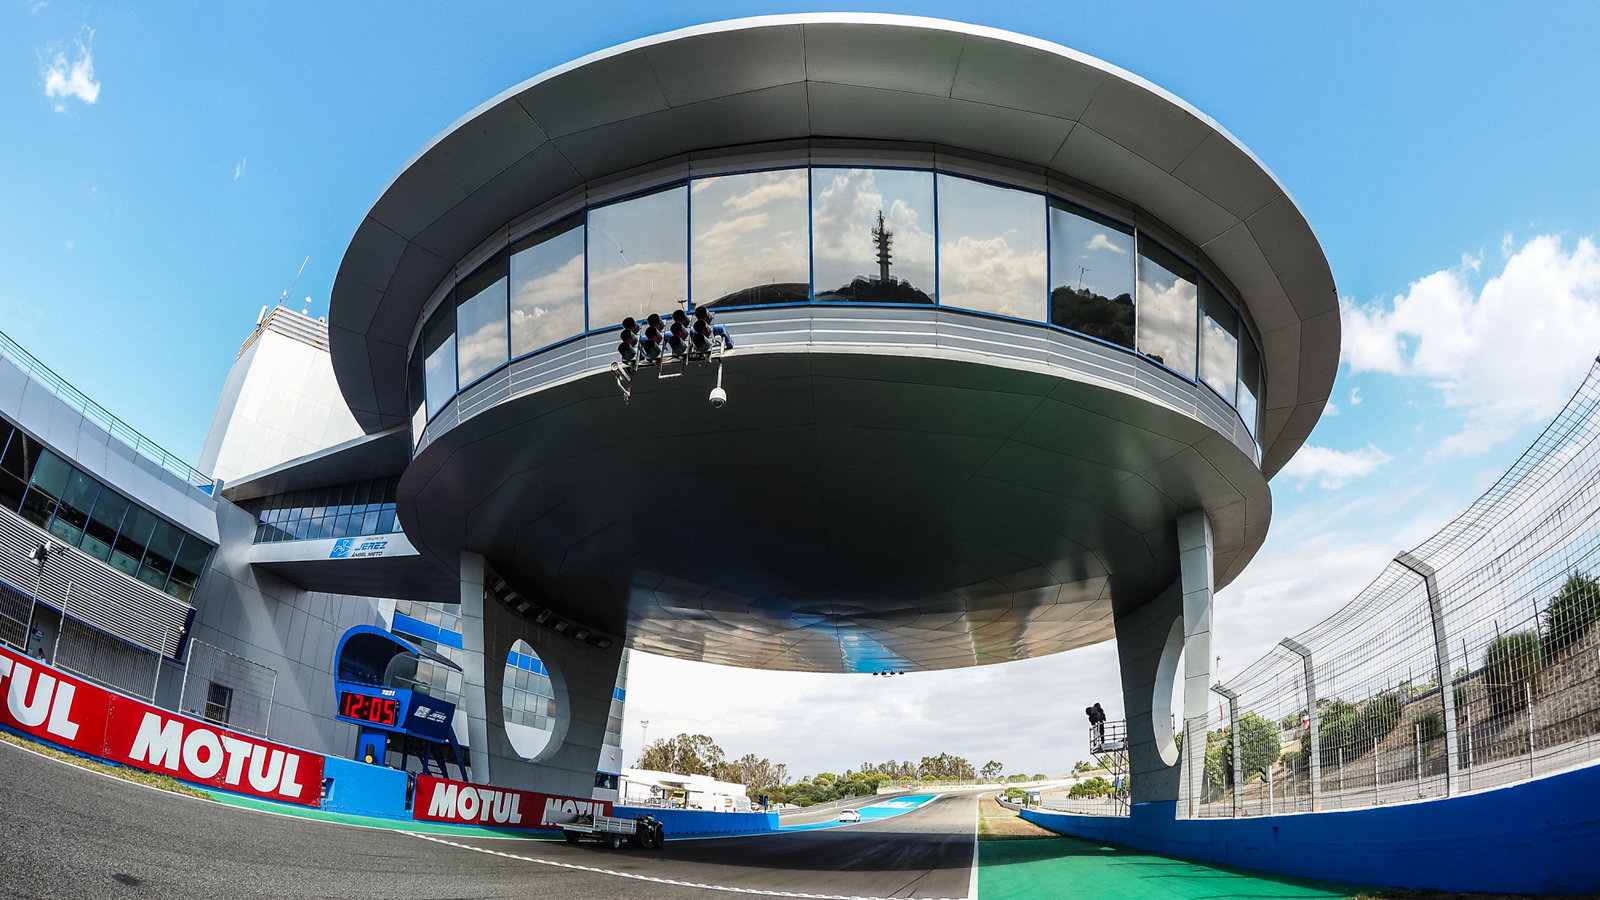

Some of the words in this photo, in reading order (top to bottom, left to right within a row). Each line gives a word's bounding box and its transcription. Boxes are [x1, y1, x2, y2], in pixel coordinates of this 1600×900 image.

[354, 541, 389, 551] JEREZ
[345, 694, 395, 725] 12:05
[129, 712, 304, 798] MOTUL
[427, 782, 523, 824] MOTUL
